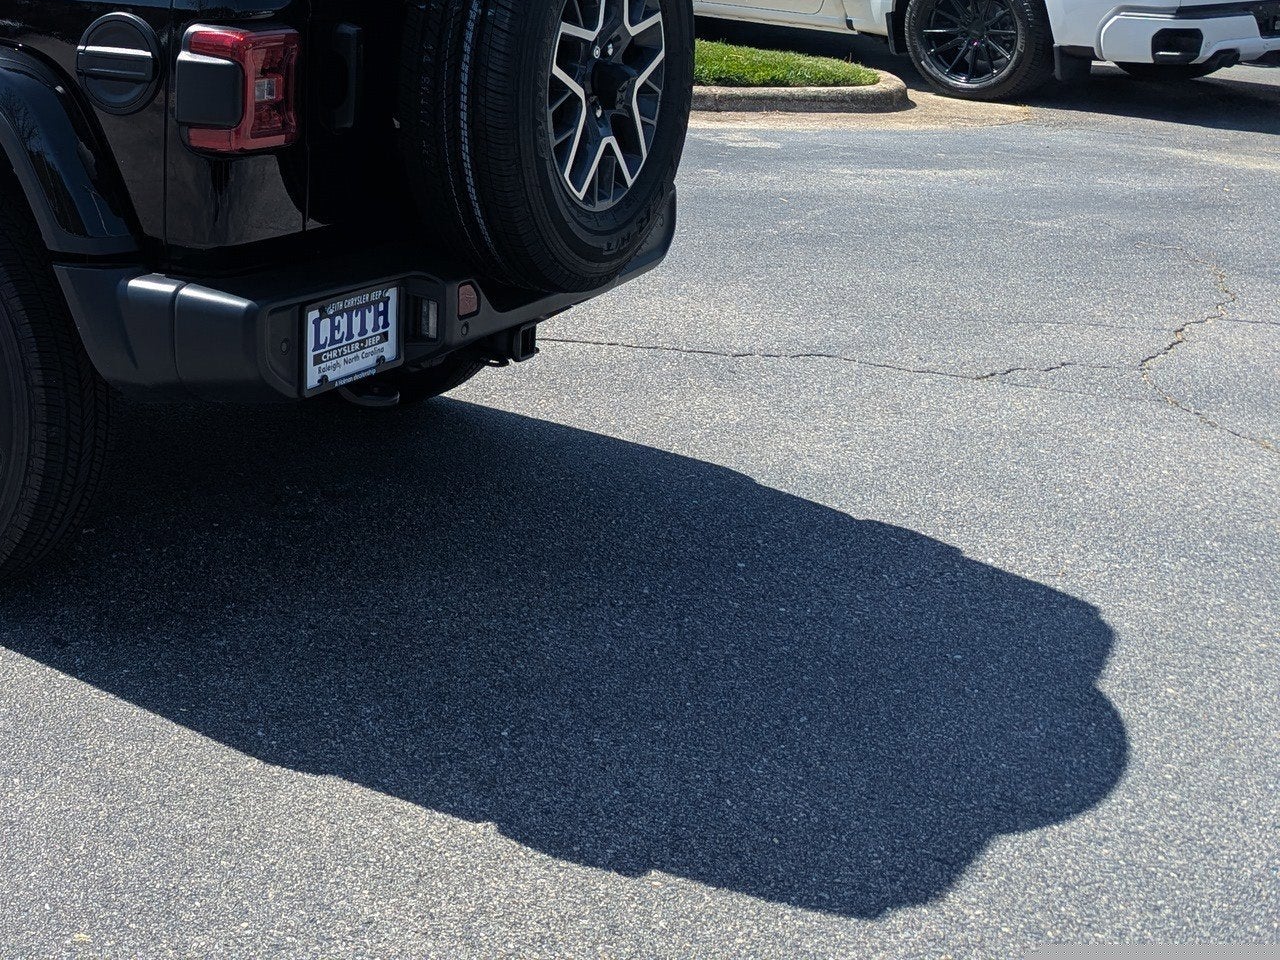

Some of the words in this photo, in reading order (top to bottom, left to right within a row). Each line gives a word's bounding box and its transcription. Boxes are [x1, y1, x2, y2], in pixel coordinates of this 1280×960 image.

[344, 293, 370, 309] CHRYSLER
[370, 289, 382, 302] JEEP
[312, 297, 390, 352] LEITH
[321, 342, 360, 361] CHRYSLER
[364, 335, 381, 348] JEEP
[343, 353, 360, 366] North
[361, 346, 385, 360] Carolina
